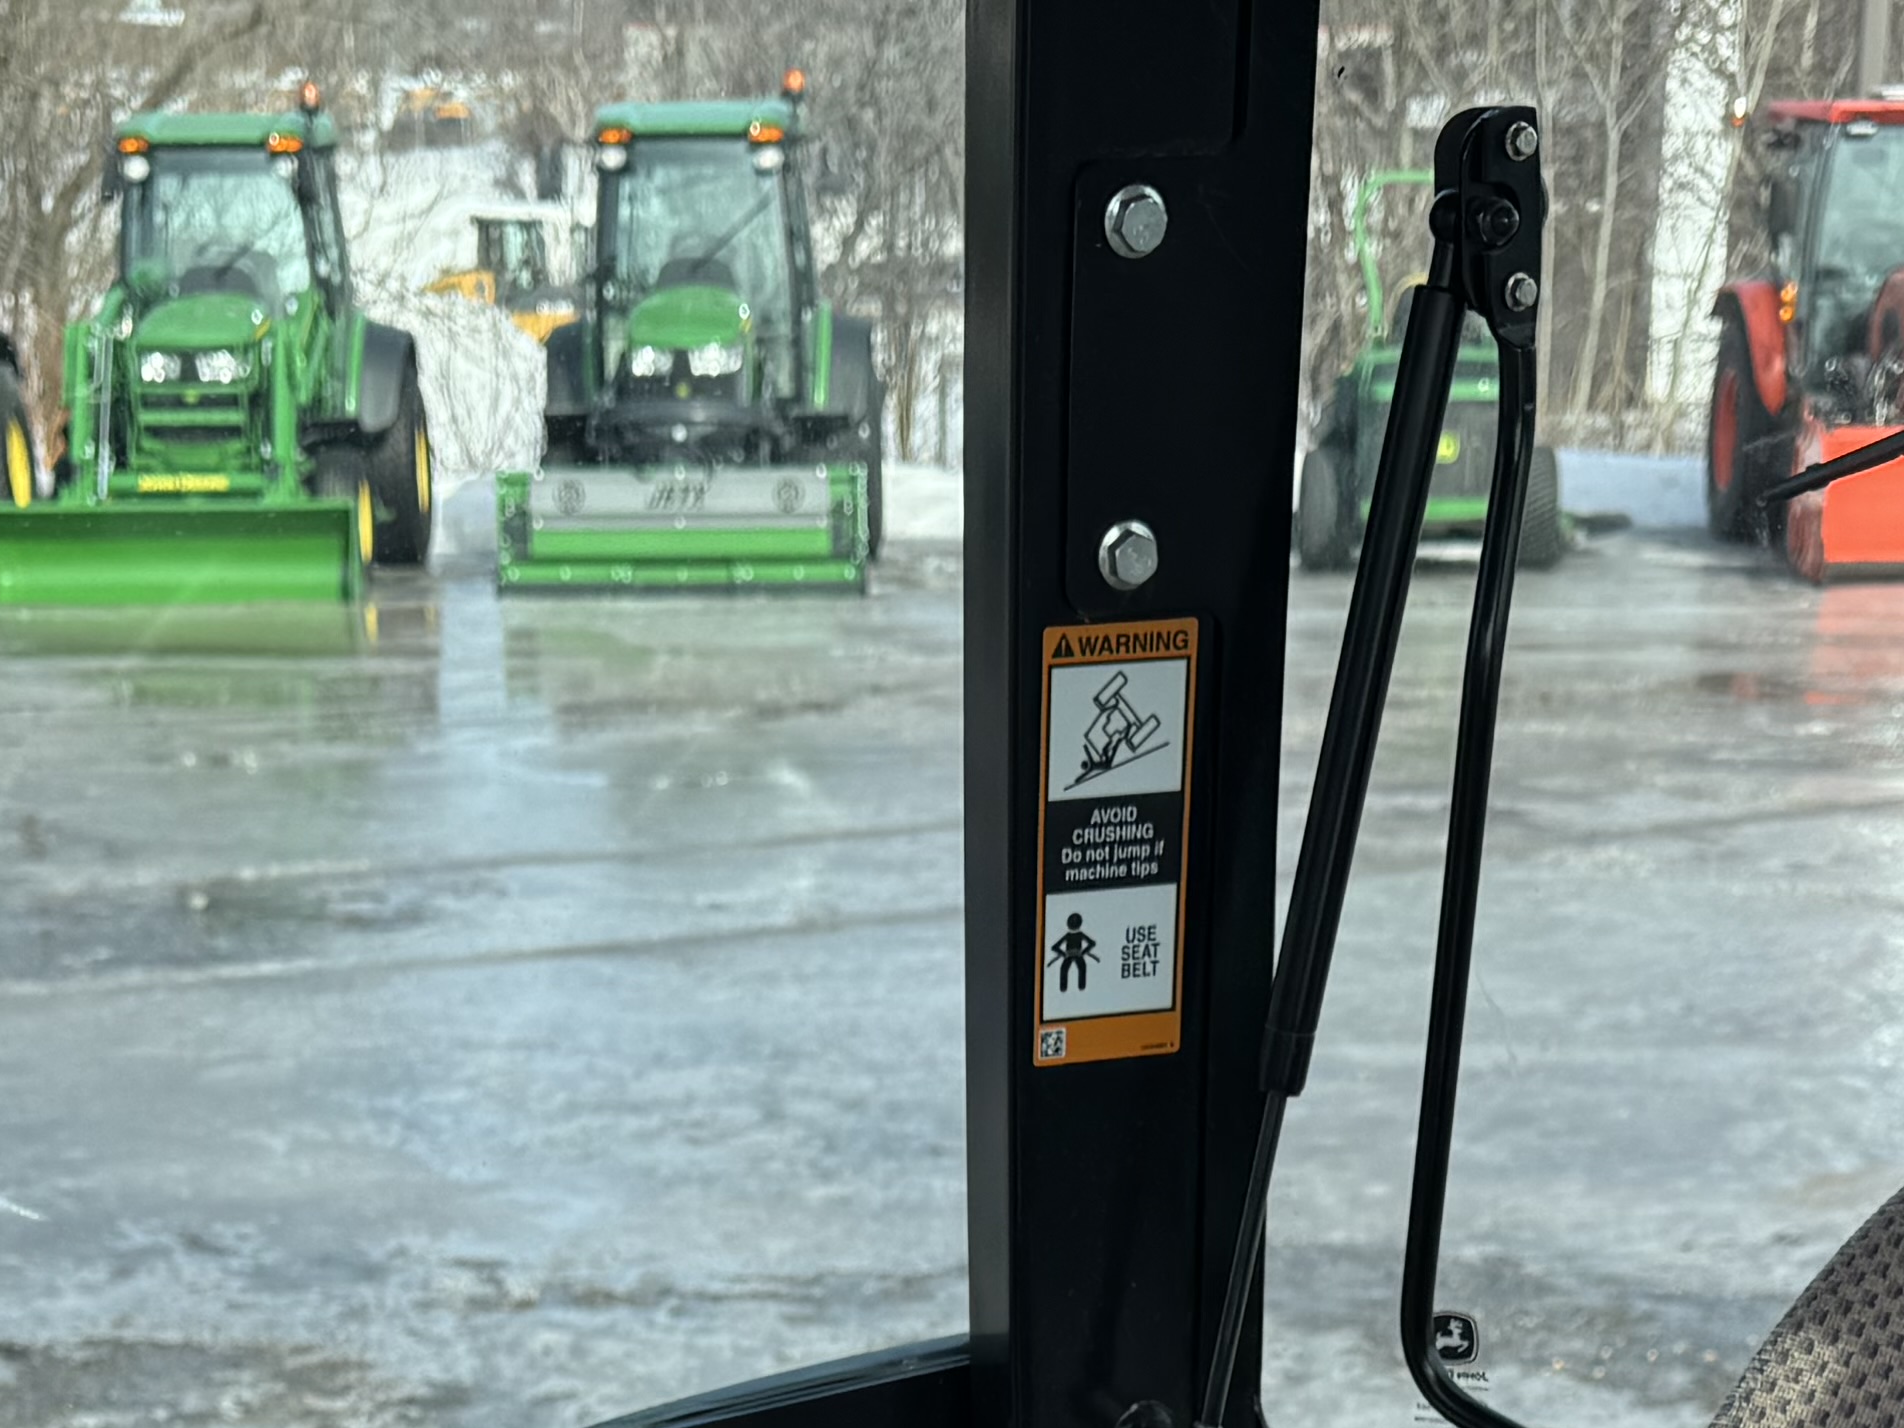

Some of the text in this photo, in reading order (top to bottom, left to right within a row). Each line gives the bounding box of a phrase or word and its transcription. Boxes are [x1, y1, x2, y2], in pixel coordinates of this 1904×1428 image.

[1078, 630, 1190, 657] WARNING
[1091, 806, 1138, 825] AVOID
[1072, 823, 1154, 845] CRUSHING
[1061, 838, 1165, 864] Do not jump if
[1065, 860, 1159, 881] machine tips
[1125, 925, 1157, 944] USE
[1121, 942, 1160, 961] SEAT
[1121, 960, 1160, 979] BELT
